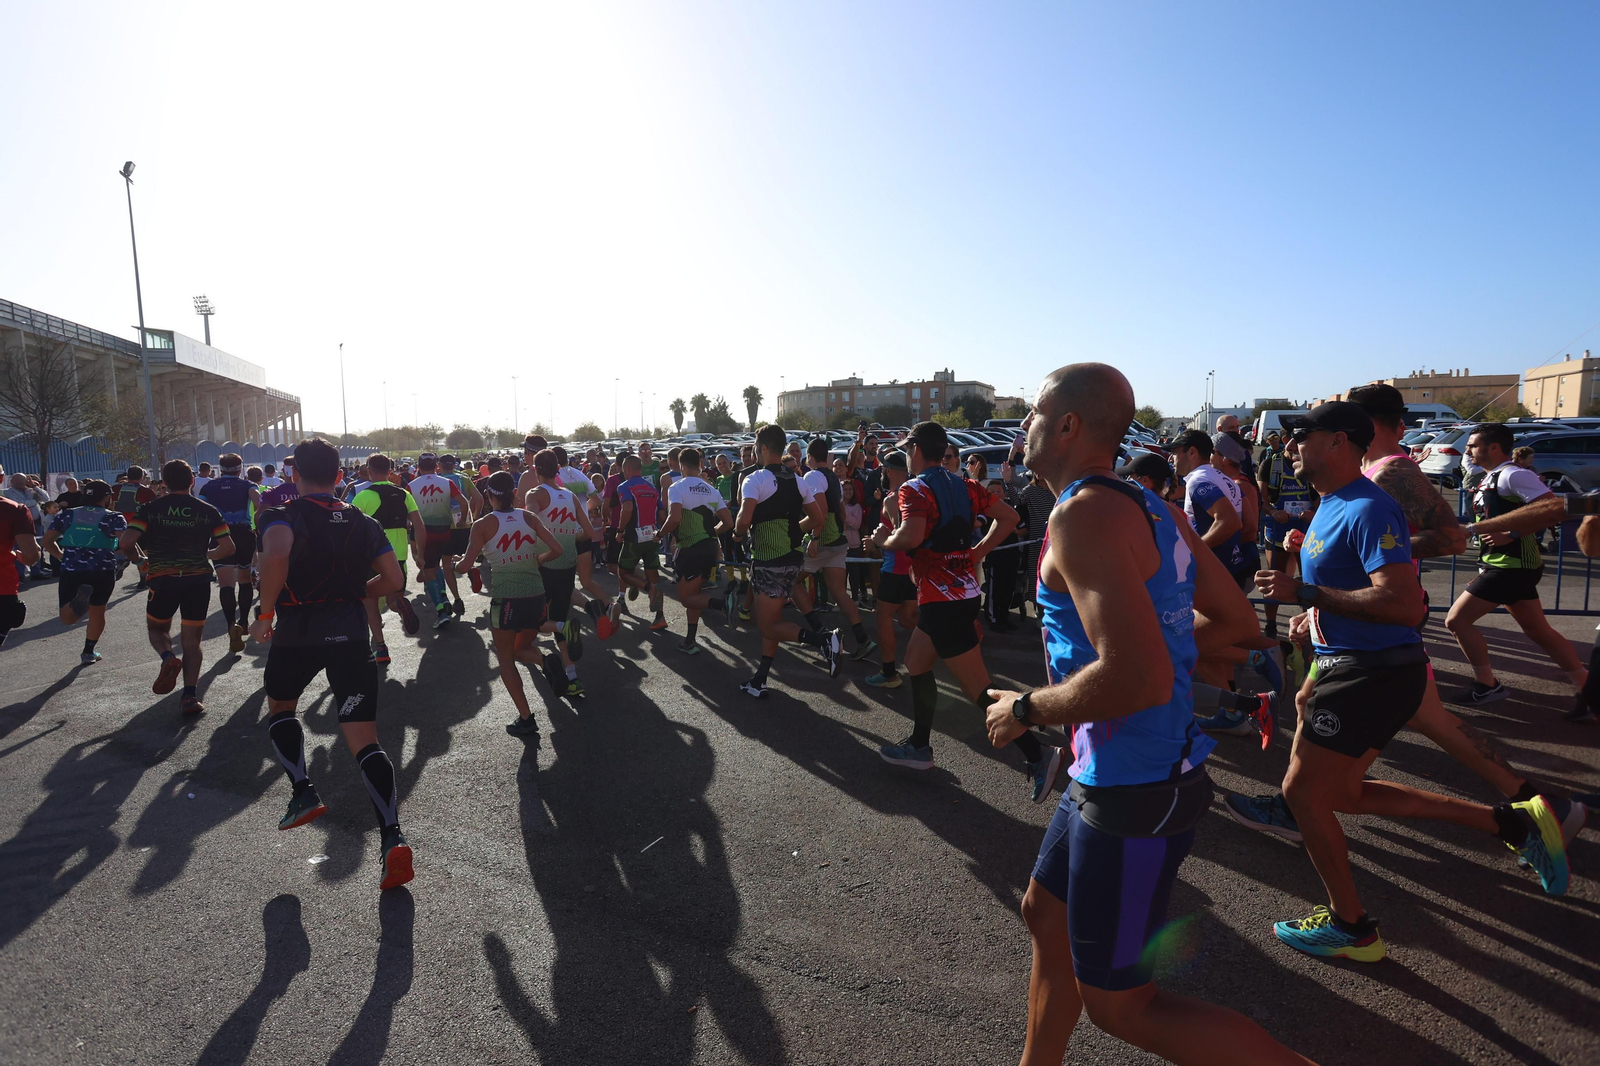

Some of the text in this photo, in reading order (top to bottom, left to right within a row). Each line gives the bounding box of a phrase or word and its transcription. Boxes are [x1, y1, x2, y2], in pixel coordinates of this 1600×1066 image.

[280, 493, 300, 501] DAV
[167, 505, 192, 517] MC
[162, 519, 195, 527] TRAINING
